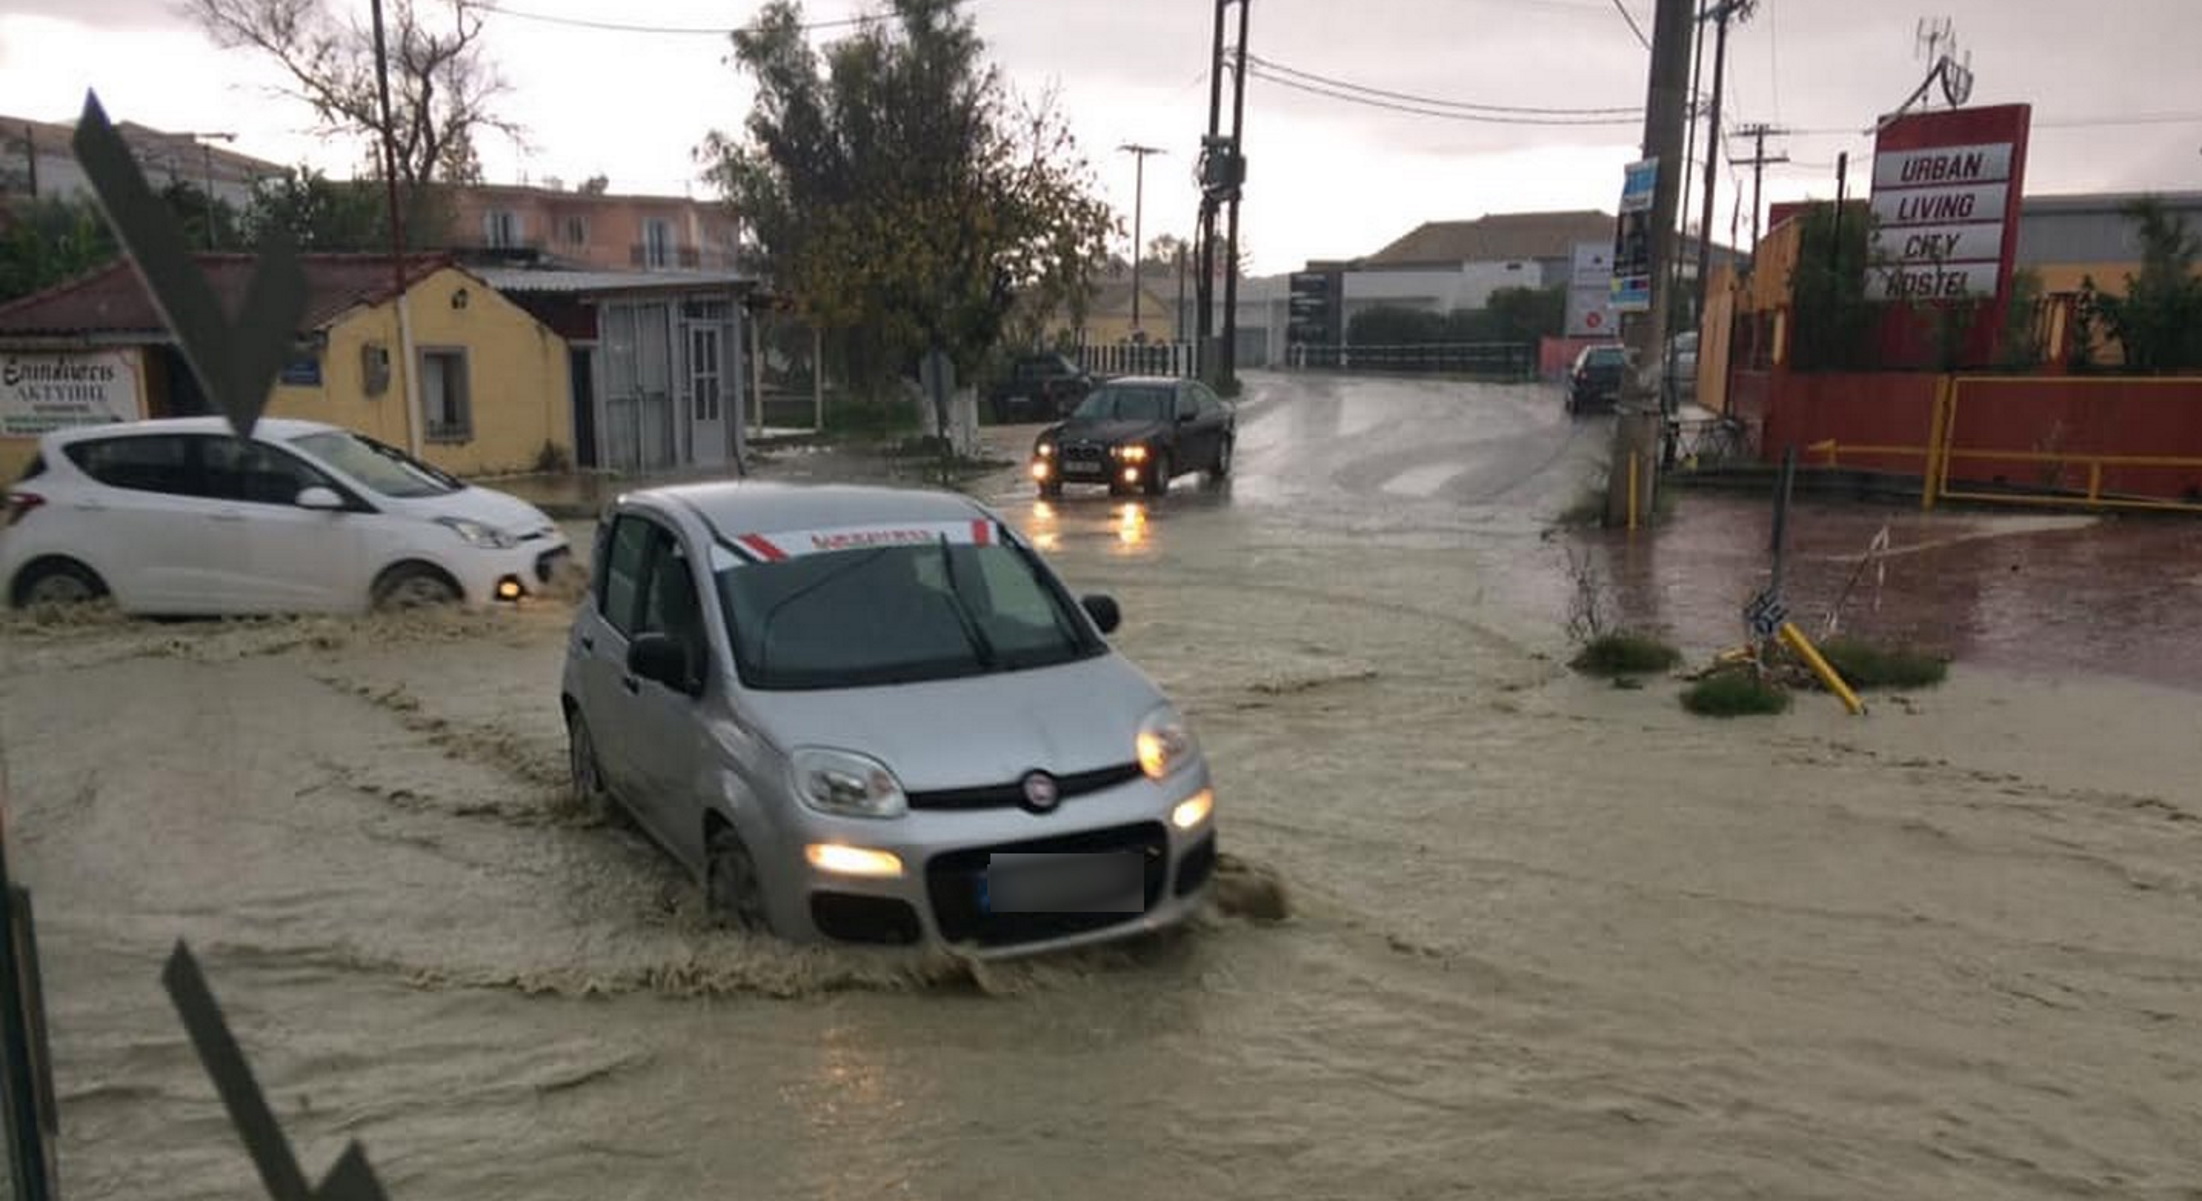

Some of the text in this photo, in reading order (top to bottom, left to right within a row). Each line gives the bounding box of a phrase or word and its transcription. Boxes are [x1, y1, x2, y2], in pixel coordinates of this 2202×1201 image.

[1901, 153, 1983, 182] URBAN
[1898, 193, 1975, 220] LIVING
[1905, 234, 1960, 258] CITY
